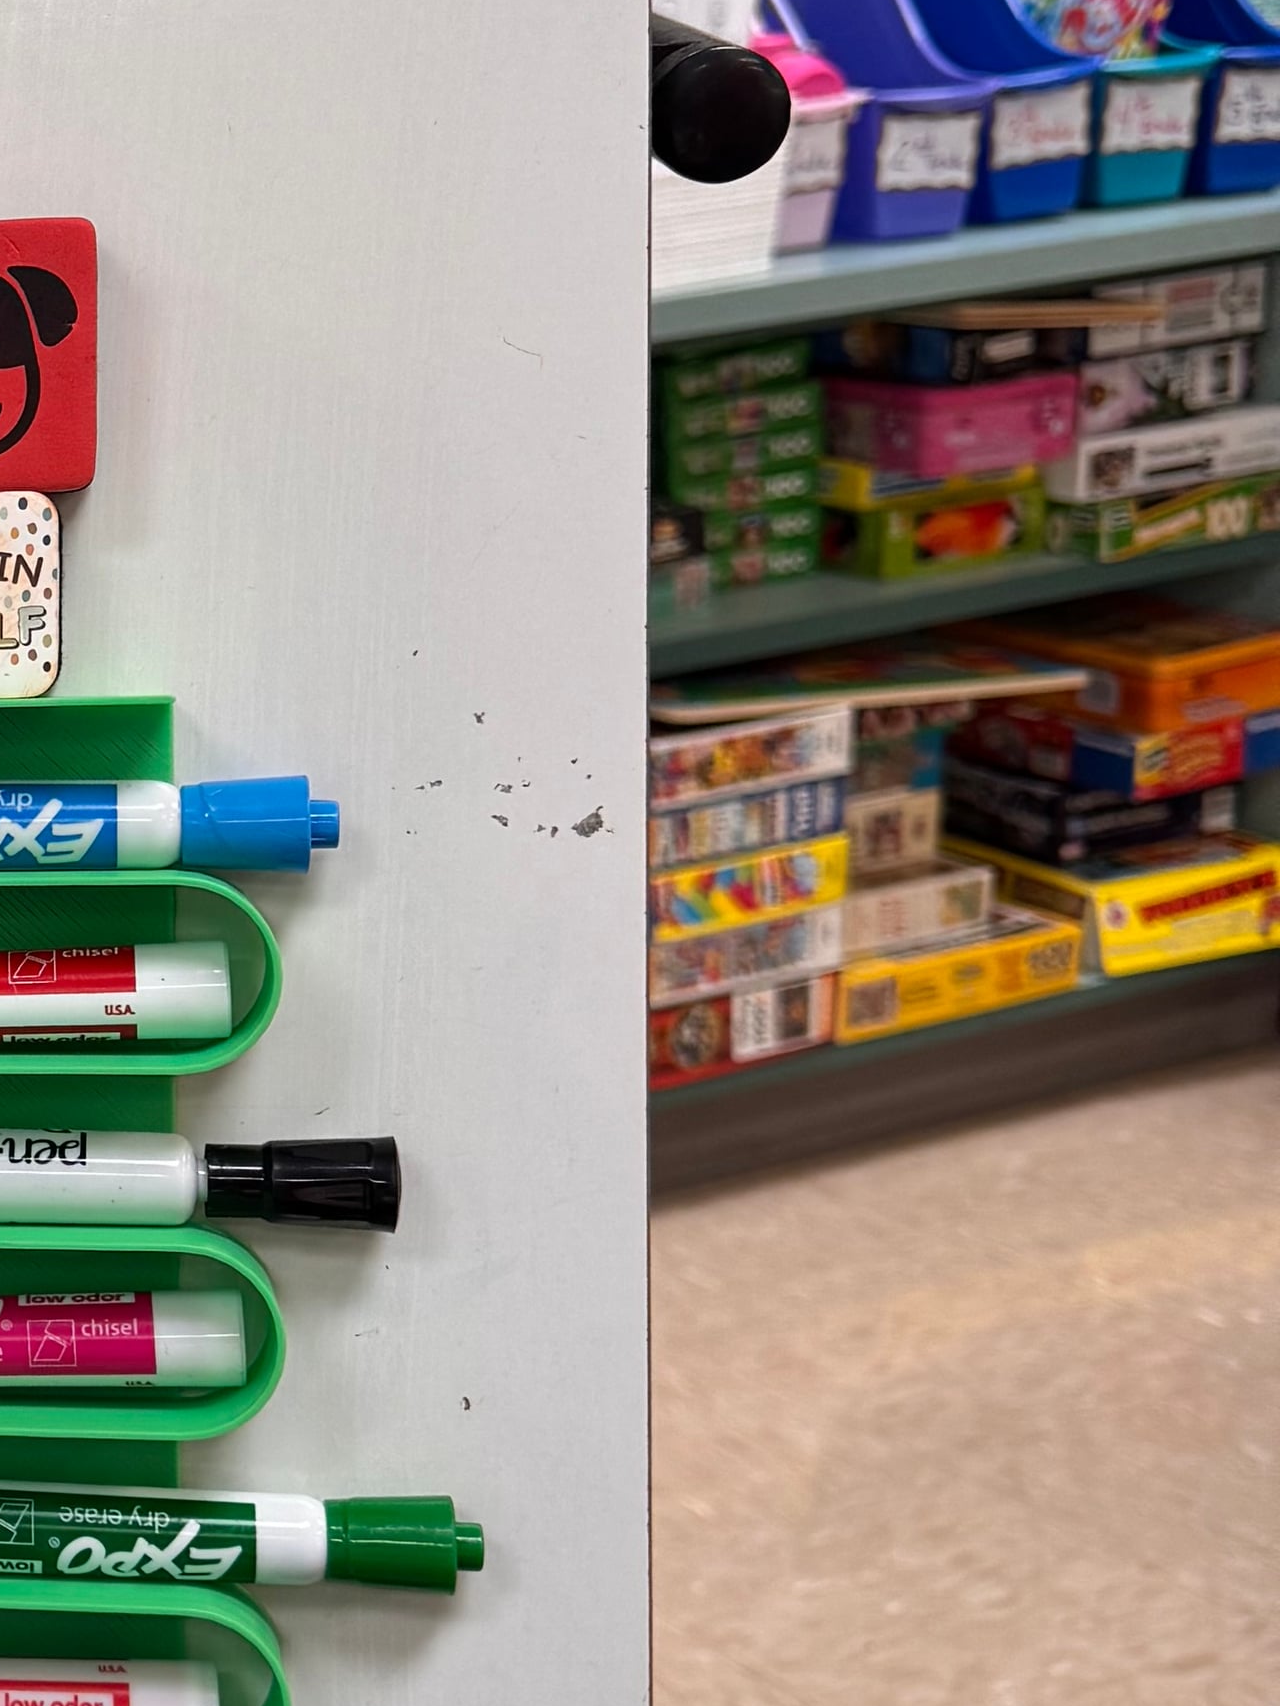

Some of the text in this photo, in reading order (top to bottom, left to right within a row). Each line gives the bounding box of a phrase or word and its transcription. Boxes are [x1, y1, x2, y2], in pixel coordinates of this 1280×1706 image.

[81, 1319, 138, 1337] chisel
[59, 1506, 170, 1532] dry erase
[56, 1522, 241, 1579] EXPO
